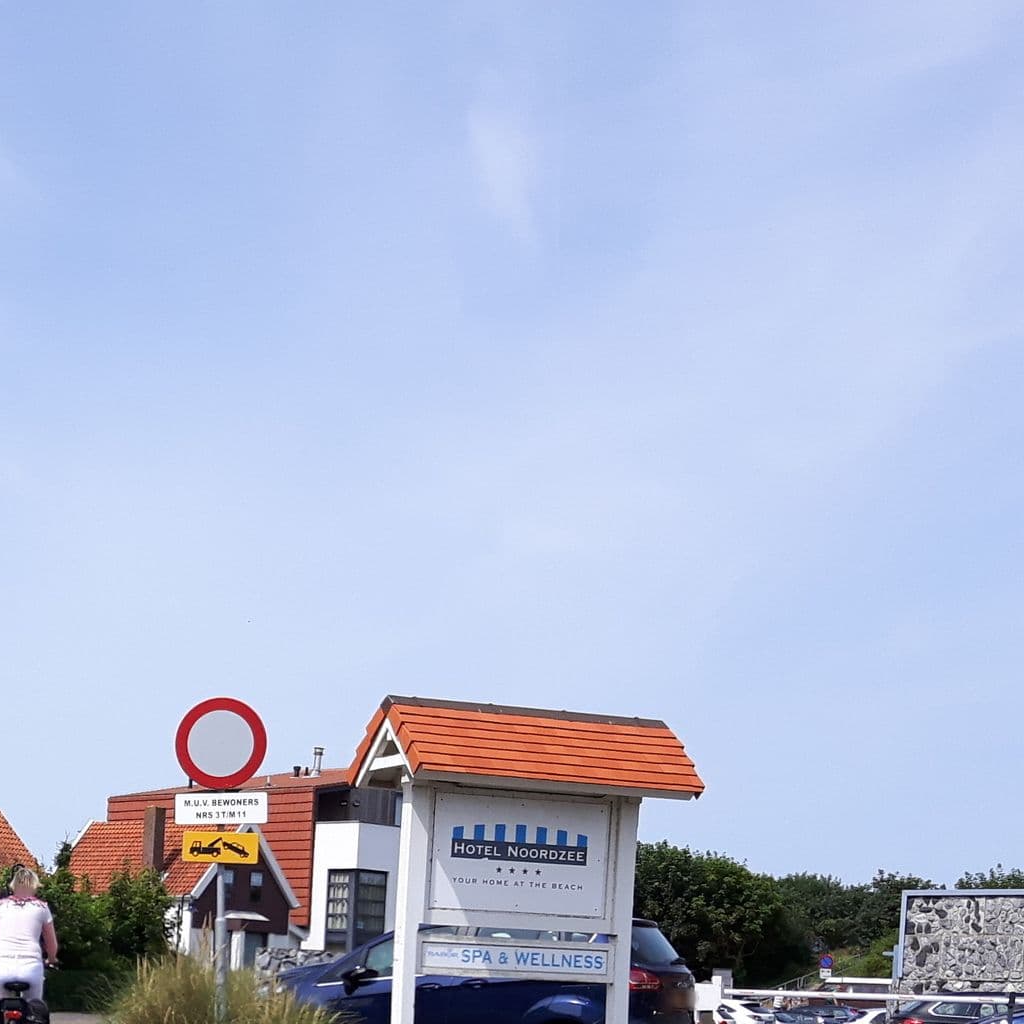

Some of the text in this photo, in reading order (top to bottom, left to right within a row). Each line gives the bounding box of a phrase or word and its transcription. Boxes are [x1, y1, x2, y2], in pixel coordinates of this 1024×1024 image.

[184, 798, 259, 807] M.U.V. BEWONERS
[195, 811, 213, 819] NRS
[237, 810, 247, 818] 11
[454, 842, 585, 862] HOTEL NOORDZEE
[452, 876, 478, 885] YOUR
[482, 879, 509, 887] HOME
[529, 881, 547, 889] THE
[551, 883, 583, 891] BEACH
[461, 949, 492, 964] SPA
[498, 952, 508, 965] &
[515, 951, 604, 969] WELLNESS
